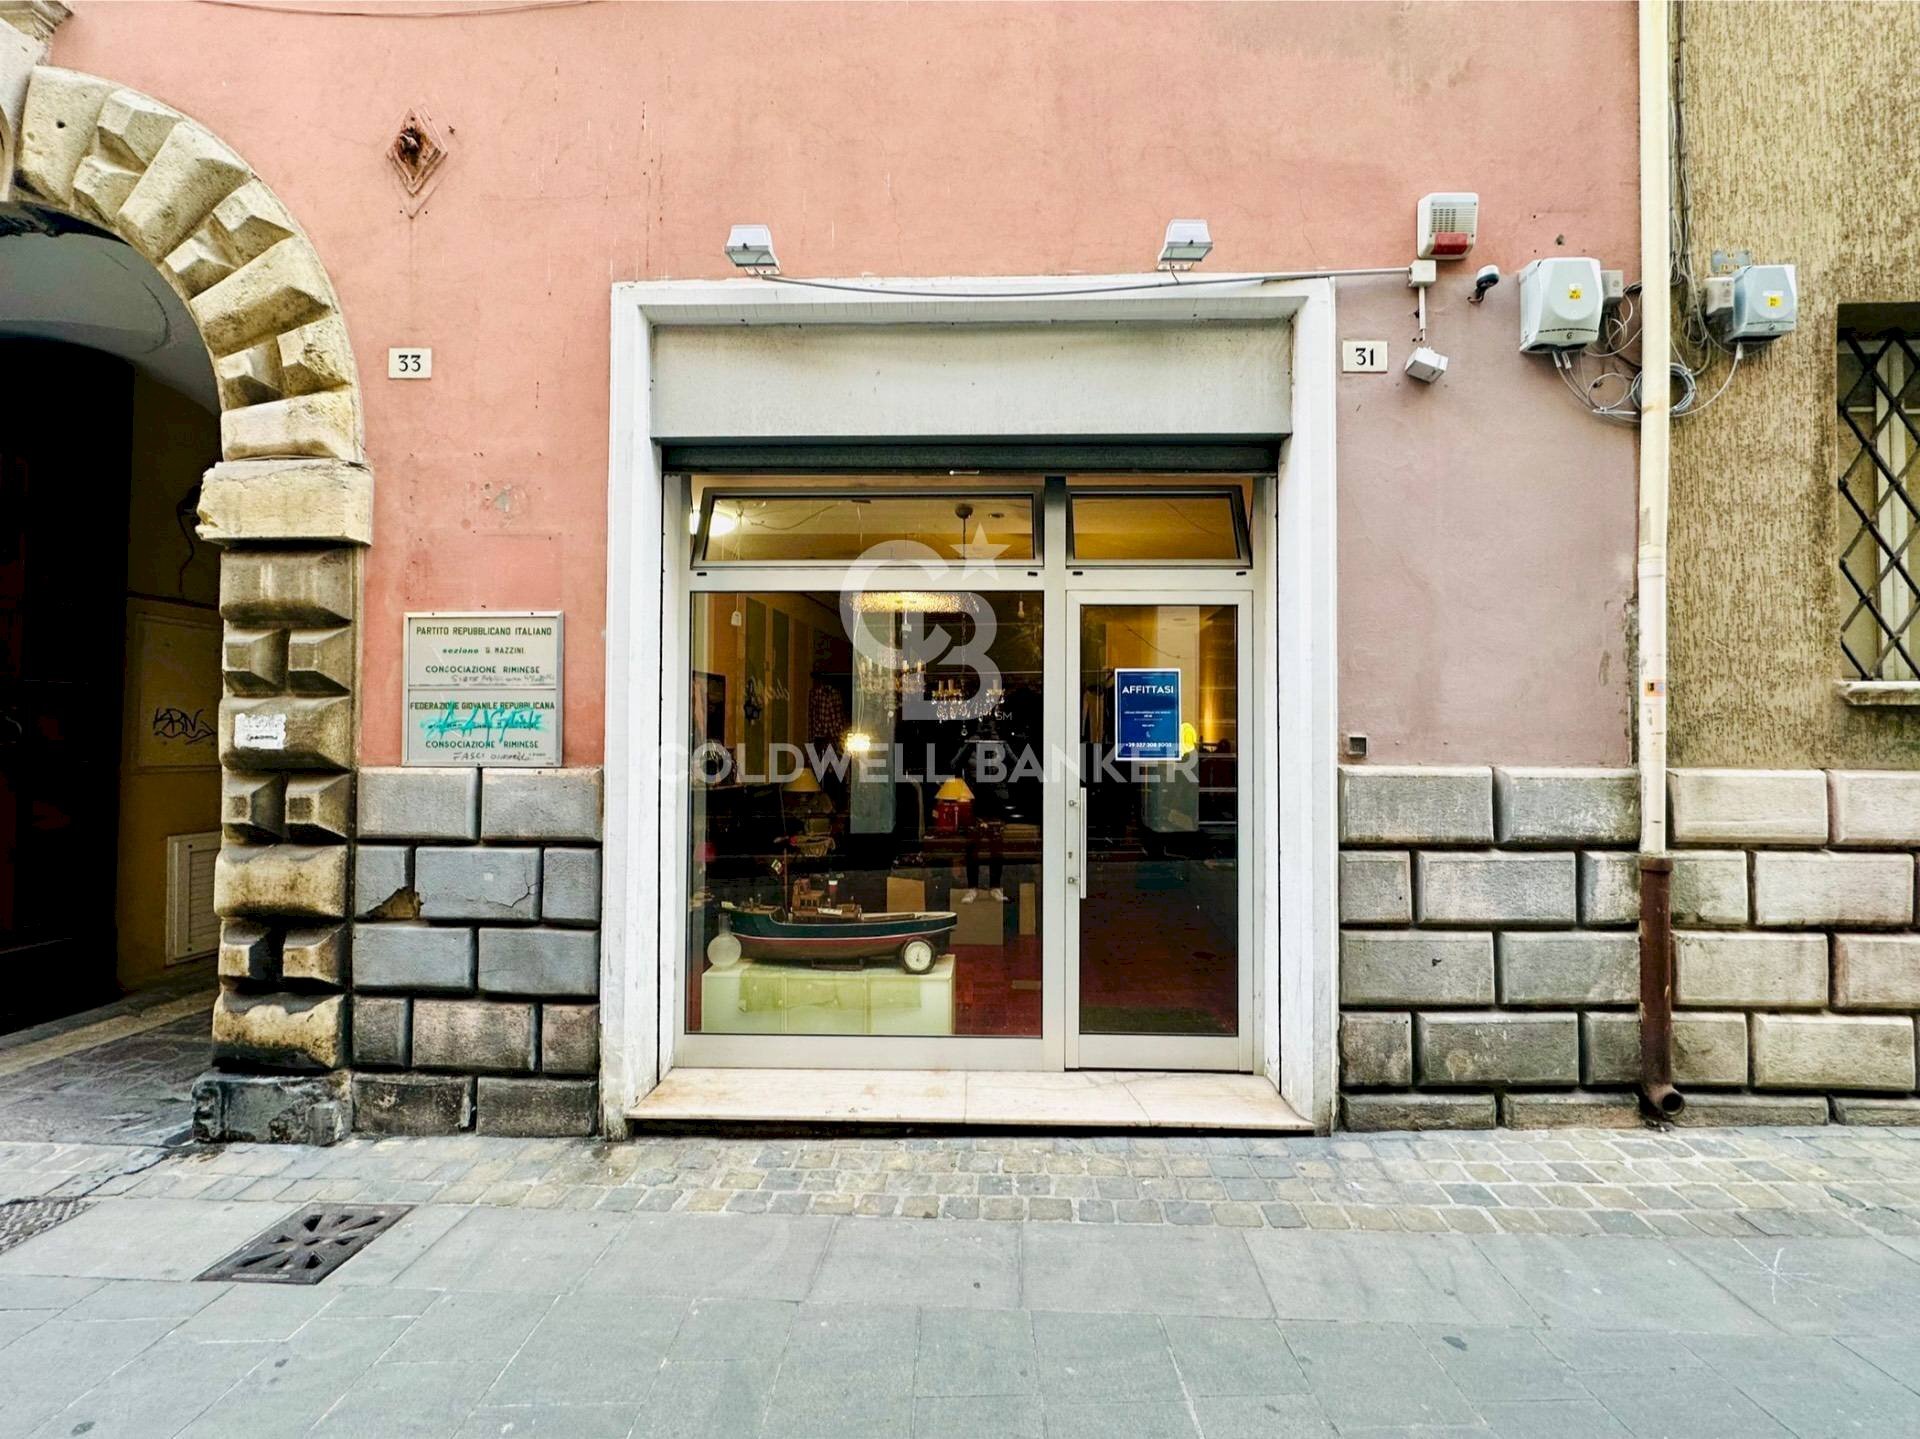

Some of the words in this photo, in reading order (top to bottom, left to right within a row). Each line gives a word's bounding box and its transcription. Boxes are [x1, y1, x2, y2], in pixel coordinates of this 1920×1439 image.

[1355, 347, 1374, 367] 31
[398, 354, 421, 372] 33
[416, 626, 449, 636] PARTITO
[452, 626, 511, 636] REPUBBLICANO
[515, 626, 552, 636] ITALIANO
[494, 646, 525, 655] MAZZINI
[503, 665, 540, 674] RIMINESE
[1122, 685, 1174, 694] AFFITTASI
[461, 701, 499, 711] GIOVANILE
[425, 740, 496, 749] CONSOCIAZIONE
[503, 740, 540, 749] RIMINESE
